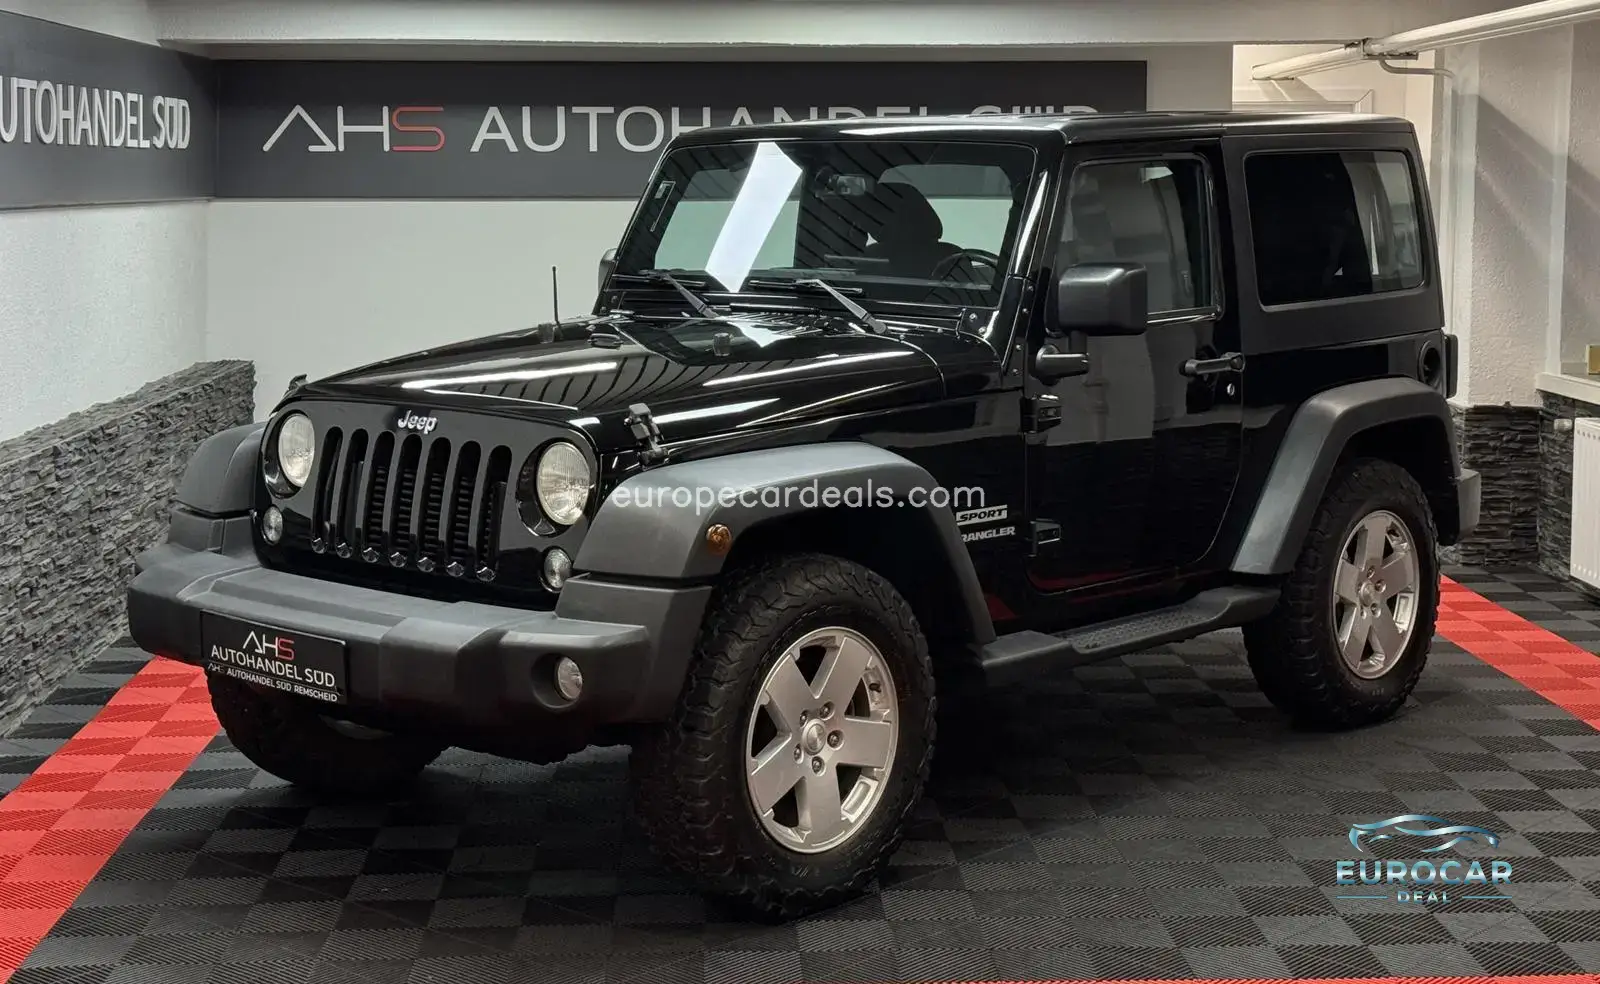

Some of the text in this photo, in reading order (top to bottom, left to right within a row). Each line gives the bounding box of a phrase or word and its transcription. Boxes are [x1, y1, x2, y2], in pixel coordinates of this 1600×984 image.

[0, 75, 150, 148] UTOHANDEL
[262, 104, 445, 152] AHS
[397, 409, 437, 434] Jeep
[958, 507, 1007, 522] SPORT
[961, 526, 1016, 542] RANGLER
[243, 630, 295, 661] AHS
[210, 644, 335, 687] AUTOHANDEL SÜD
[226, 667, 276, 688] AUTOHANDEL
[275, 680, 292, 692] SÜD
[293, 684, 338, 703] REMSCHEID
